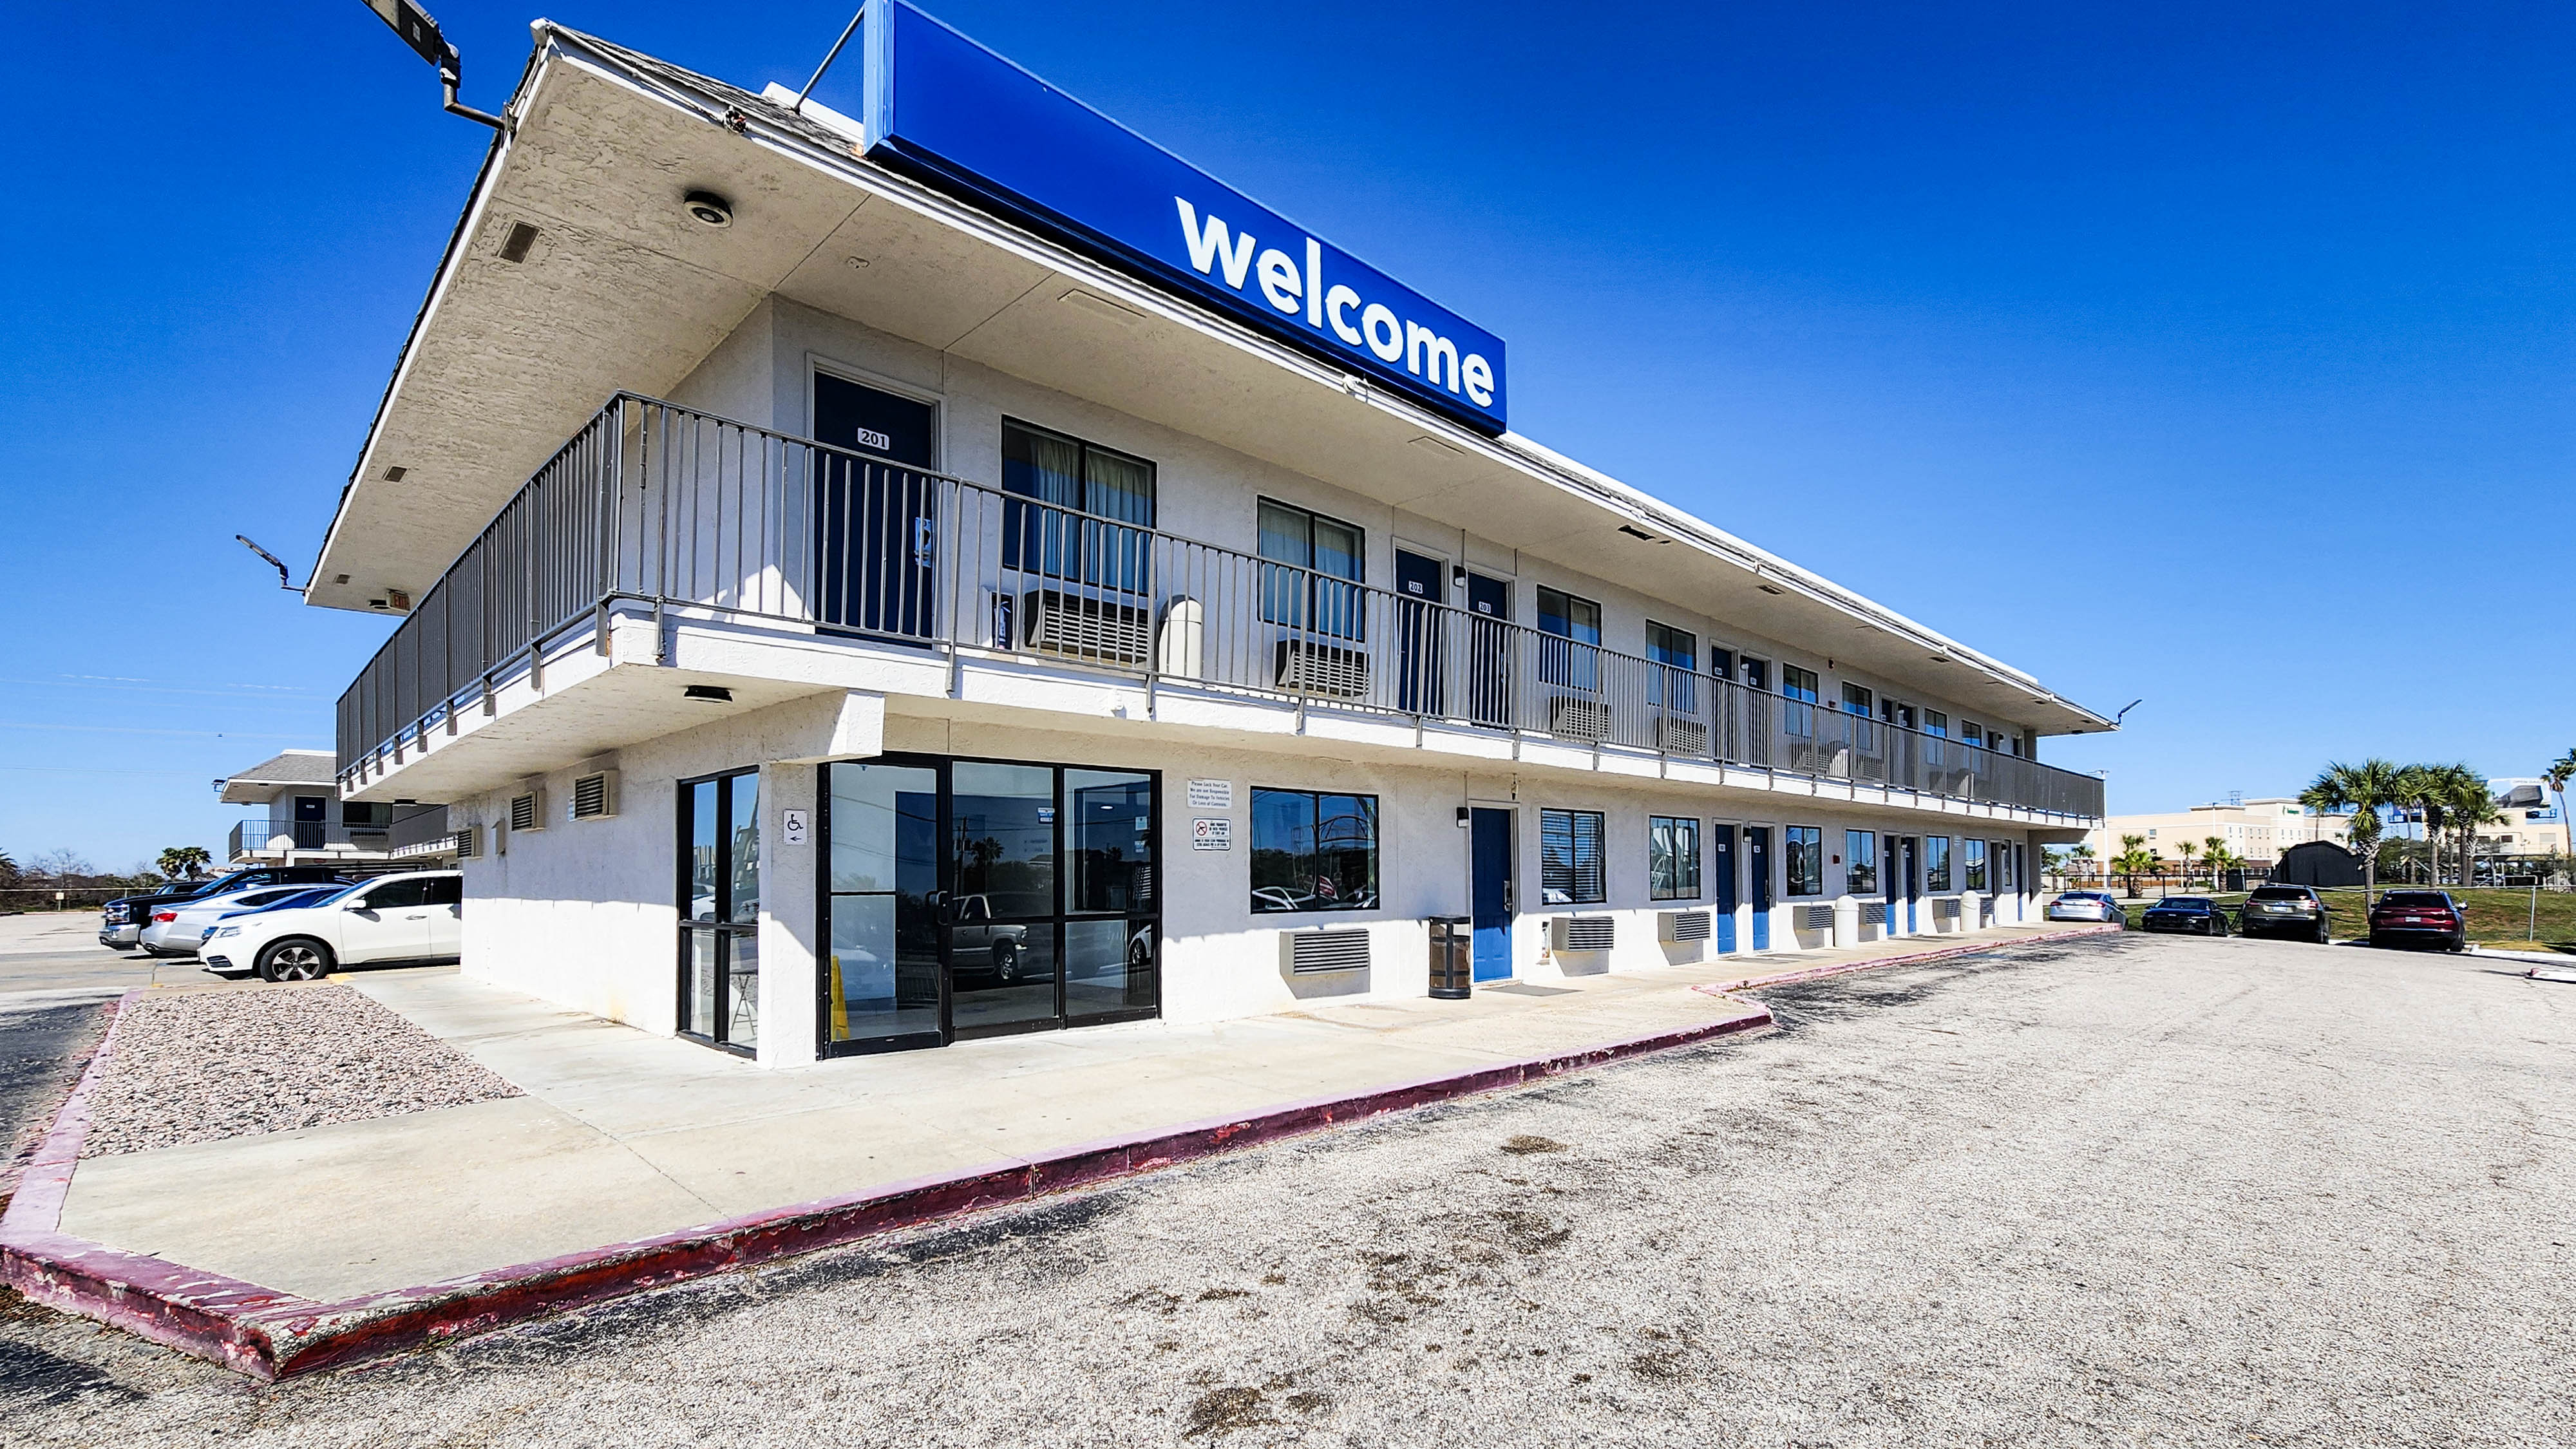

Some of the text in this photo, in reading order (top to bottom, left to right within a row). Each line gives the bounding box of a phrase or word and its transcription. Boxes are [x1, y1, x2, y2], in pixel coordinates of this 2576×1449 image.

[1174, 195, 1495, 408] welcome
[861, 430, 886, 448] 201
[1410, 582, 1422, 592] 202
[1479, 603, 1490, 612] 203
